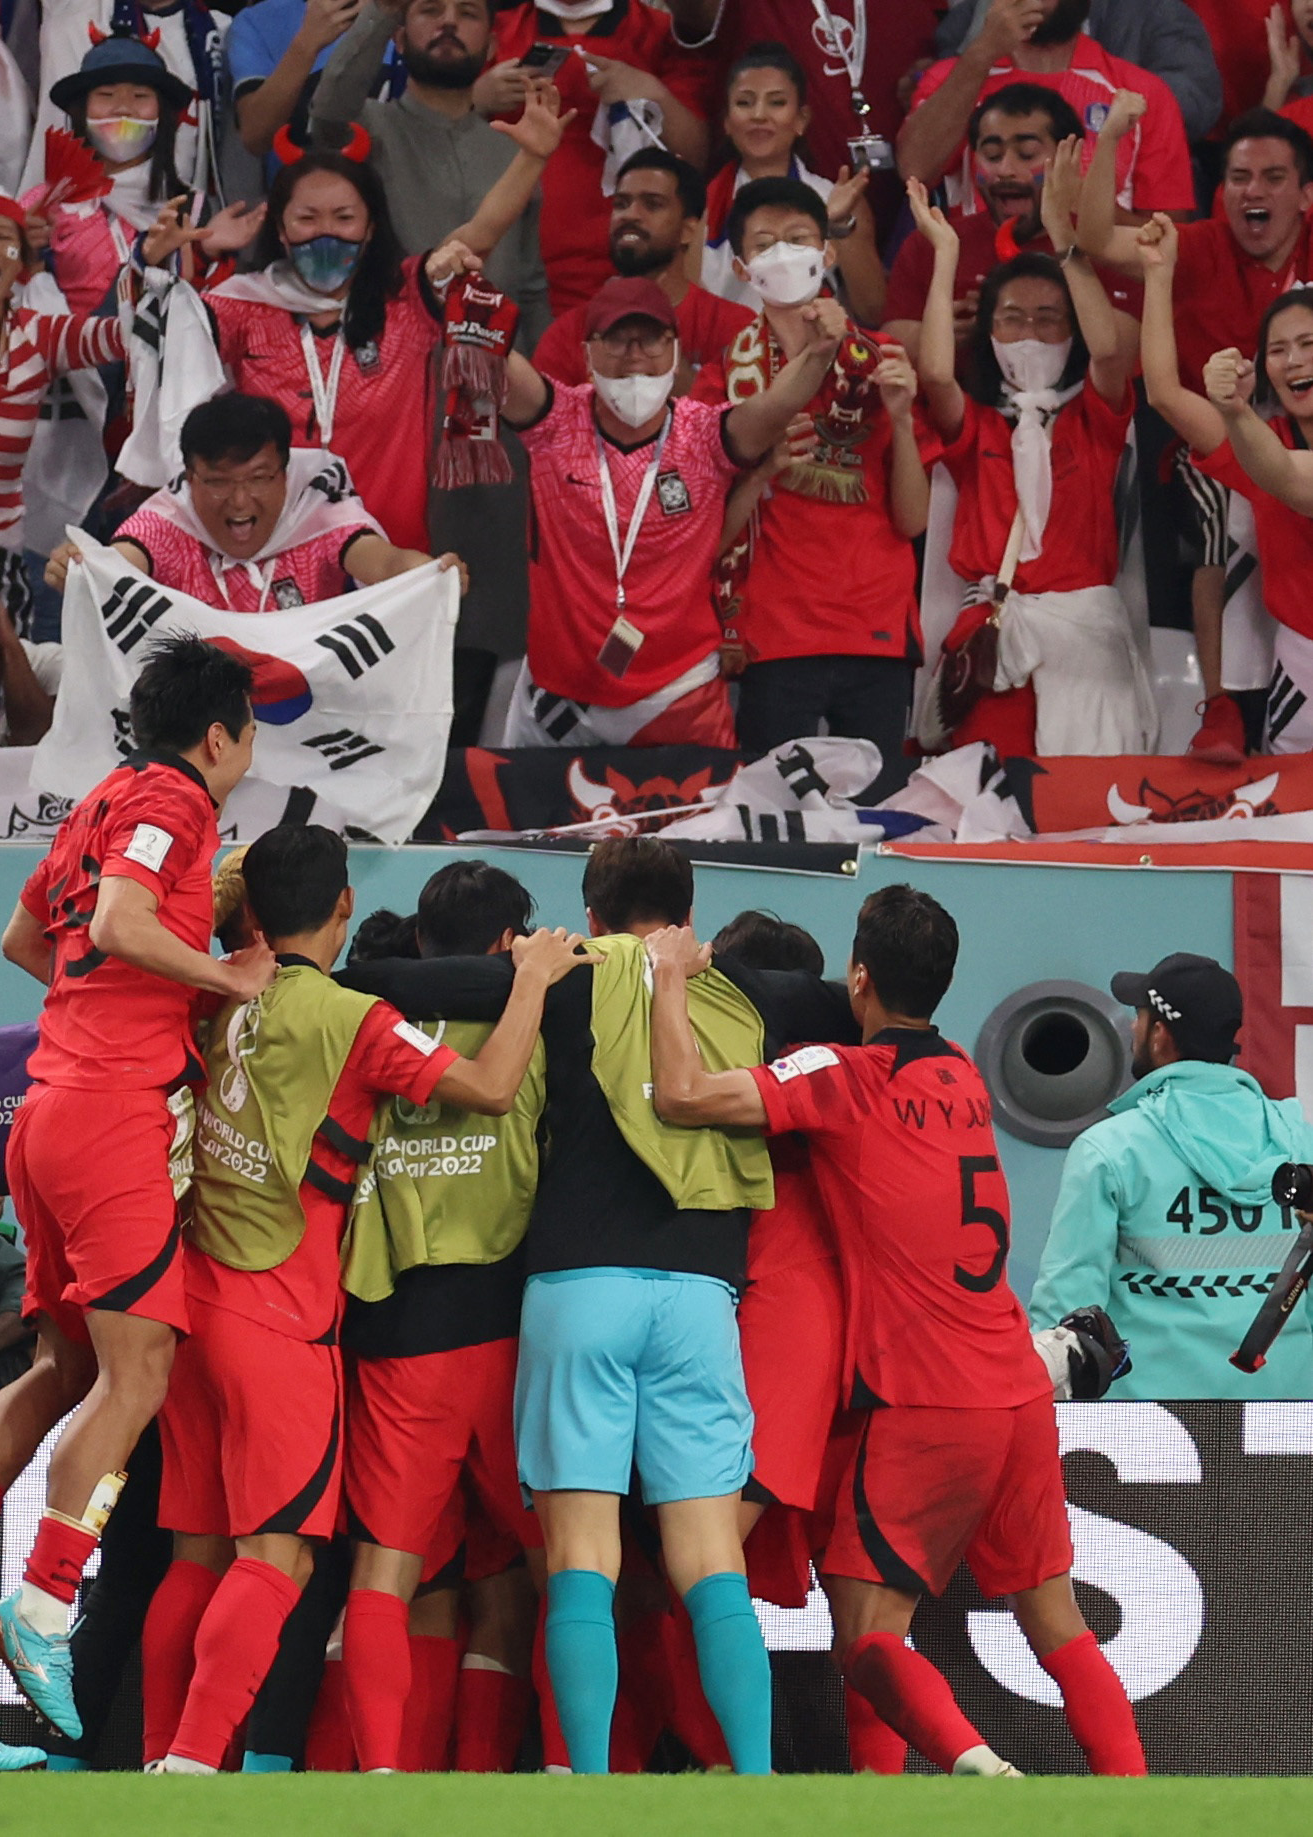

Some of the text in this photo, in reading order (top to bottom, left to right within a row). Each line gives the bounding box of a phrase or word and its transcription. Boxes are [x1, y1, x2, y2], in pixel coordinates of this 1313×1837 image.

[202, 1111, 247, 1151] WORLD
[891, 1097, 926, 1129] W
[936, 1099, 954, 1129] Y
[460, 1135, 497, 1152] CUP
[954, 1155, 1011, 1293] 5
